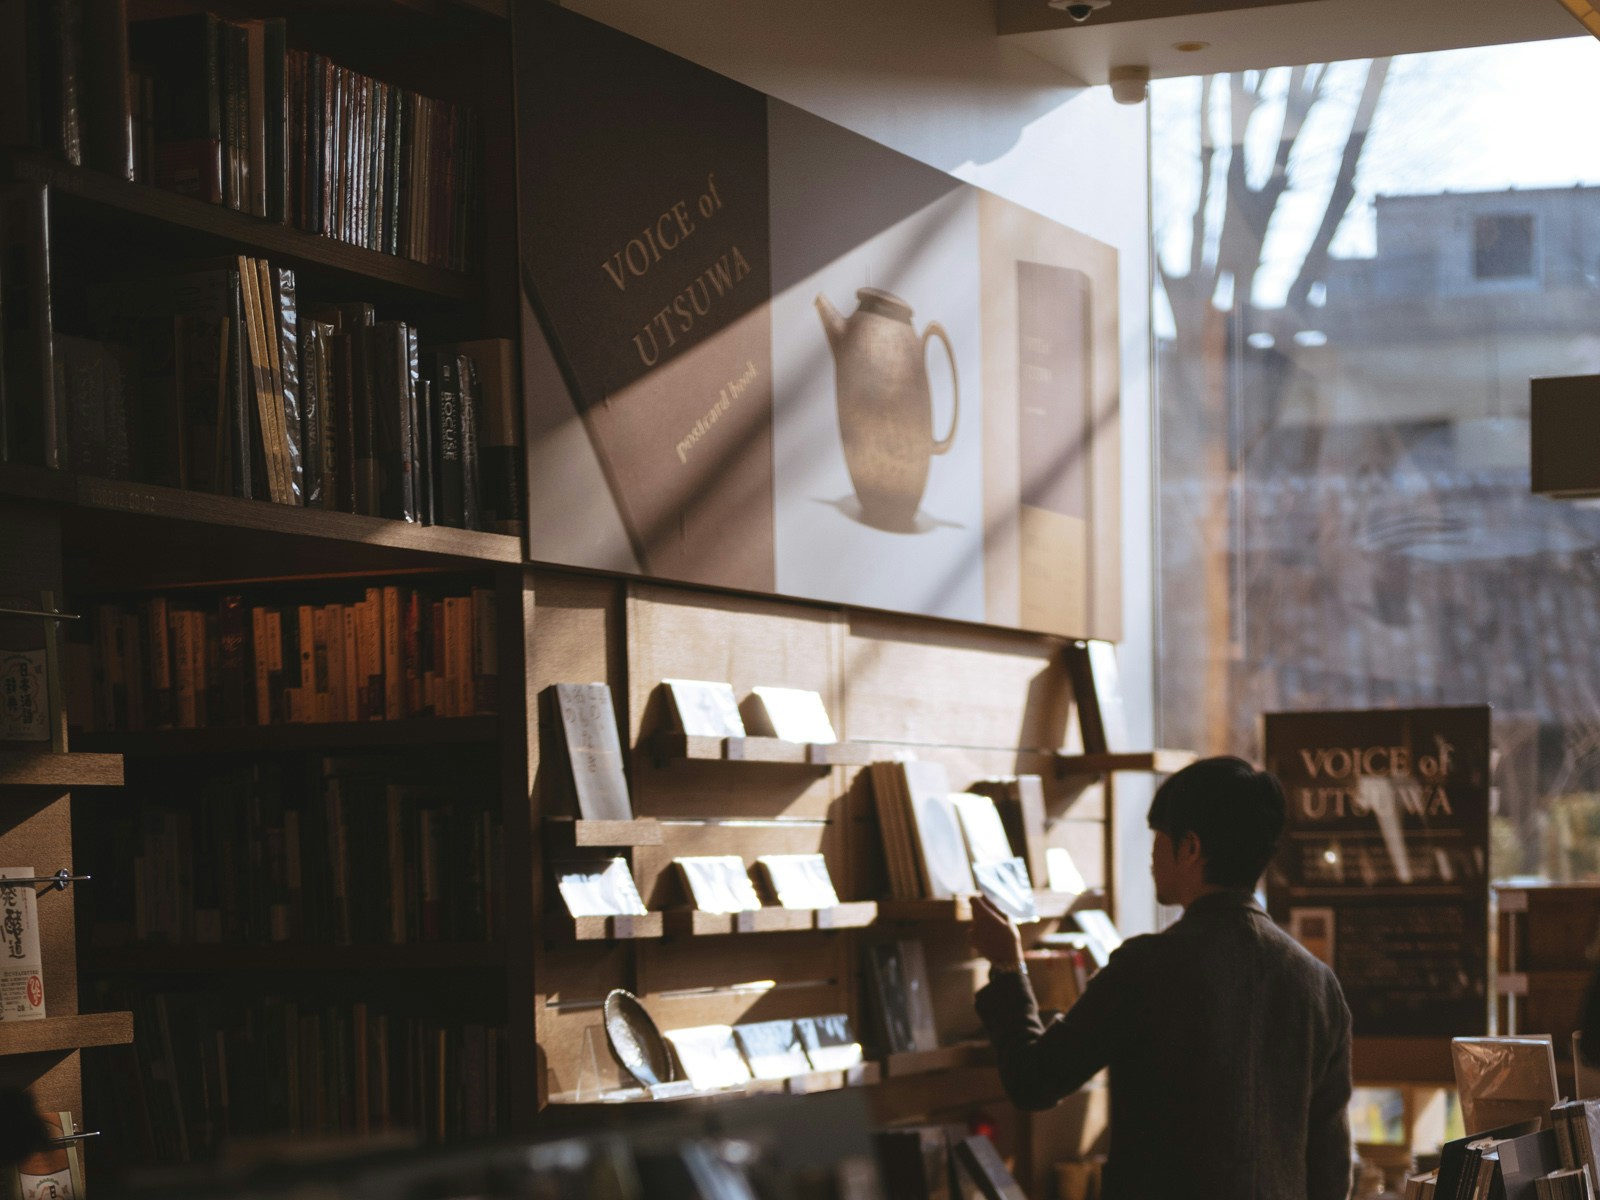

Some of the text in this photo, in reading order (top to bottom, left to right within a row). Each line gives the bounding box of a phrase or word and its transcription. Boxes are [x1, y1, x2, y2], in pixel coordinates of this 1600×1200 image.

[602, 172, 723, 292] VOICE of
[631, 245, 752, 367] UTSUWA
[675, 360, 758, 465] postcard book
[1298, 743, 1455, 779] VOICE of
[1302, 786, 1453, 818] UTWA
